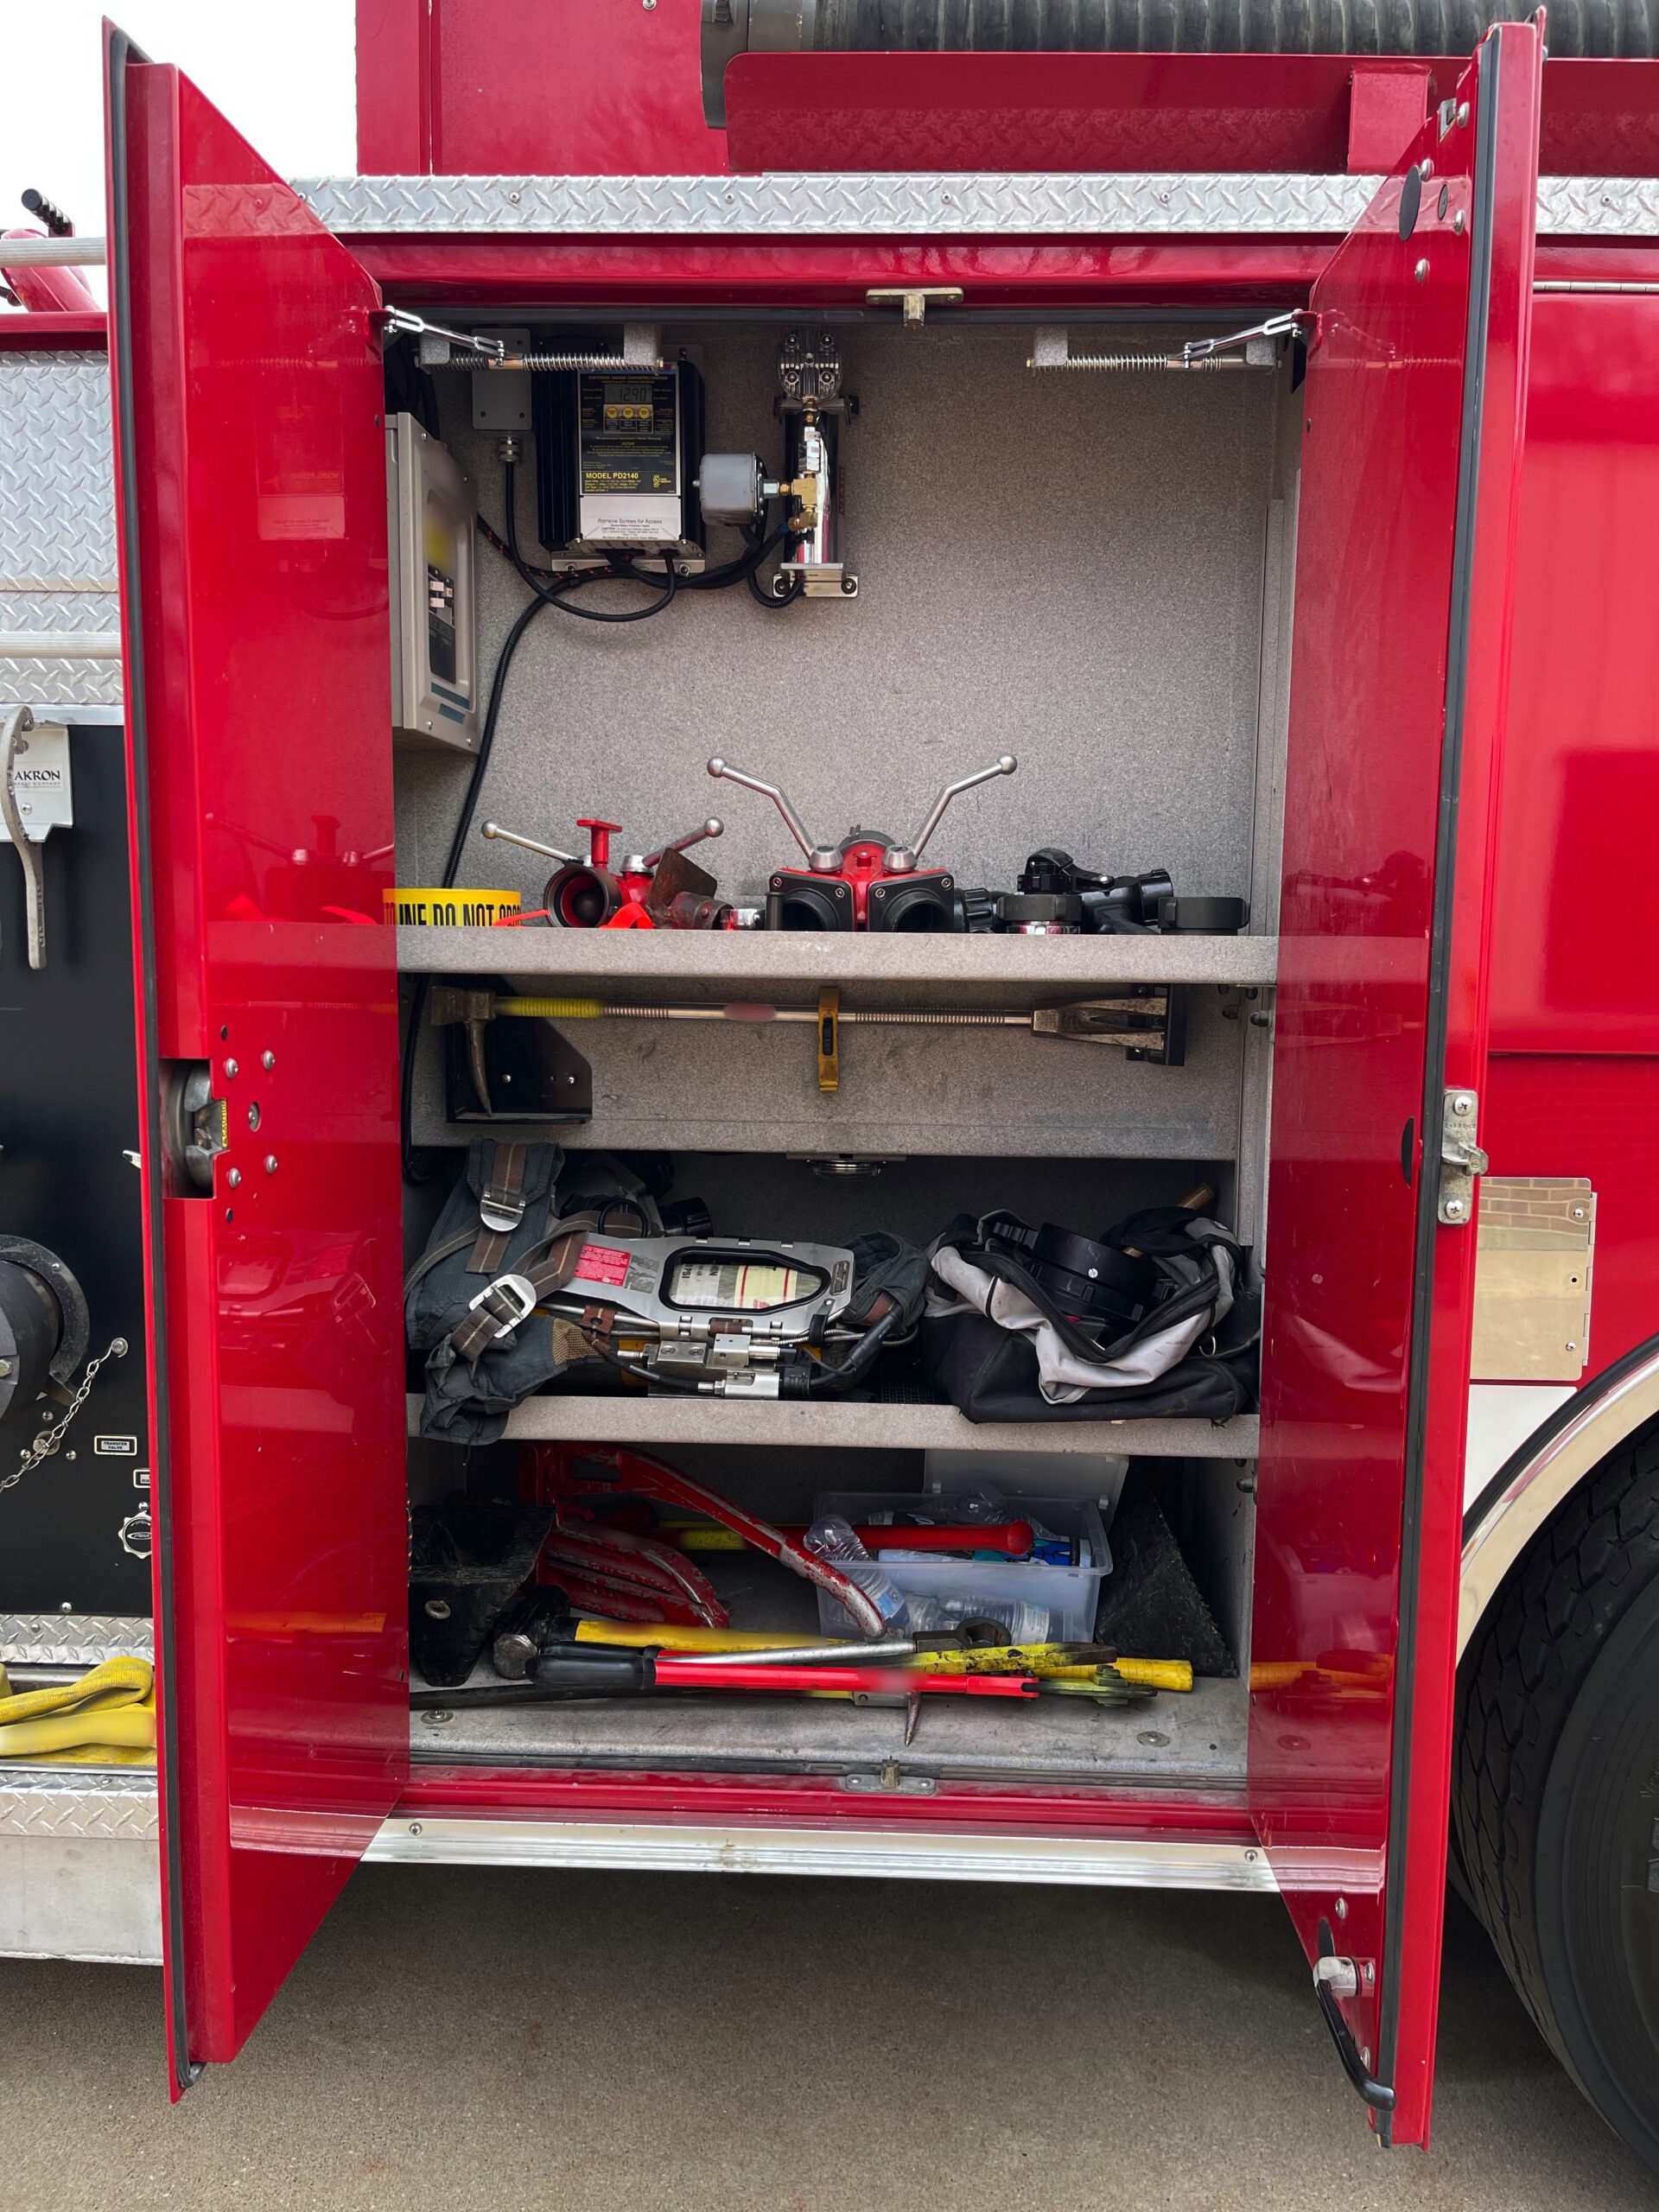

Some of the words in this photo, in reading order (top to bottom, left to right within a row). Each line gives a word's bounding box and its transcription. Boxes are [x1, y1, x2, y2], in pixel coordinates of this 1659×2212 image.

[14, 770, 60, 781] AKRON
[398, 903, 427, 926] INE
[433, 903, 456, 926] DO
[463, 903, 494, 926] NOT
